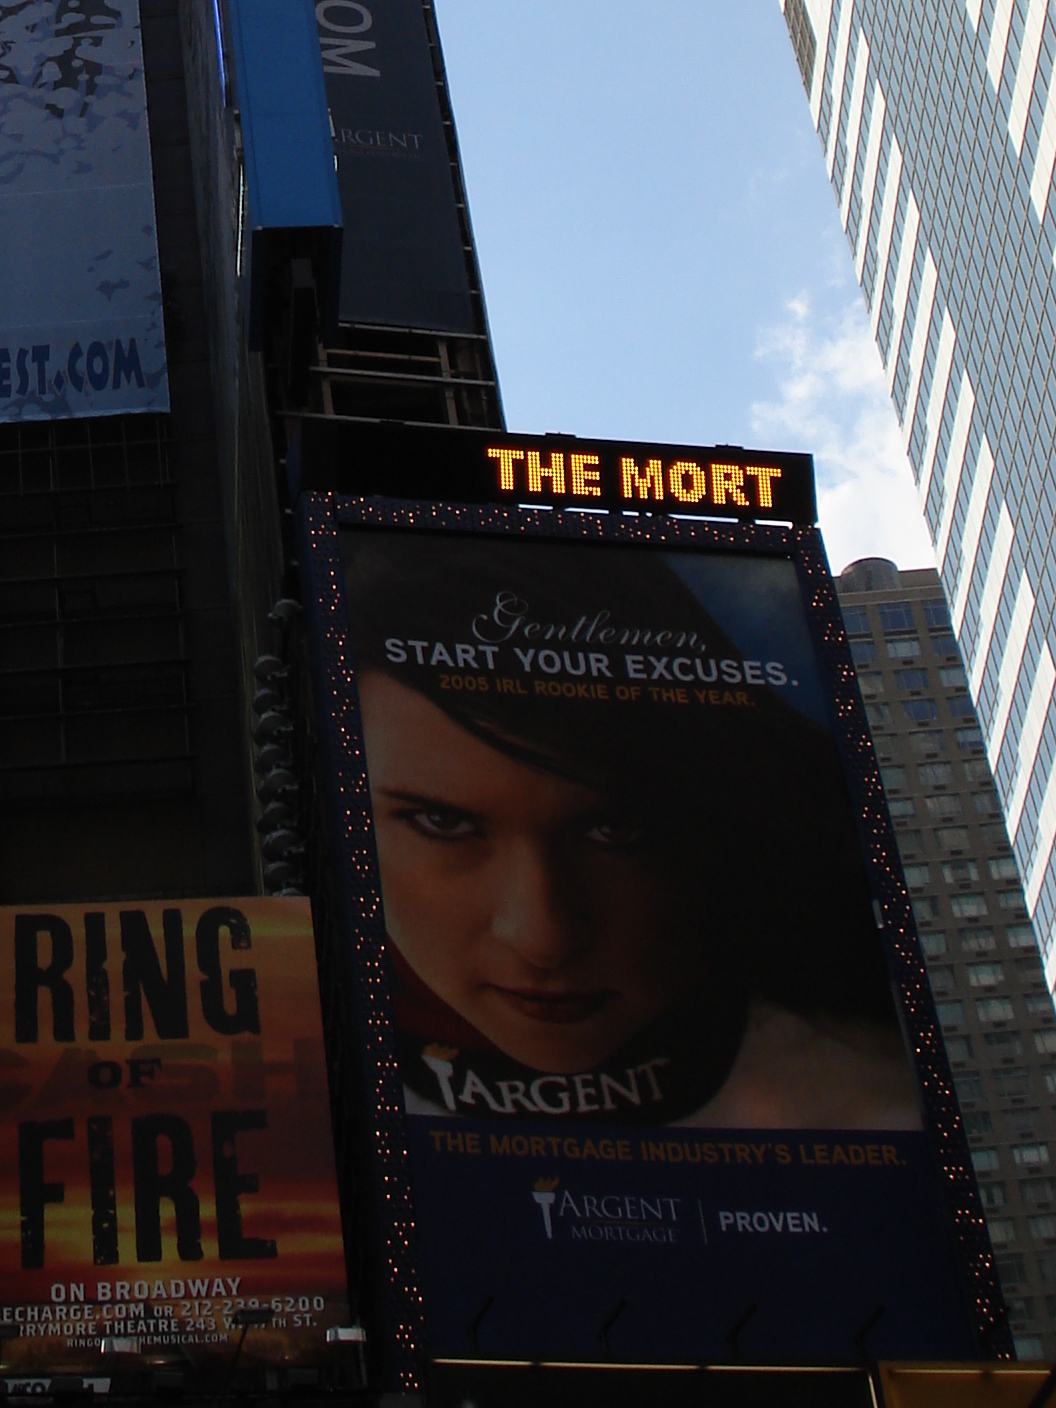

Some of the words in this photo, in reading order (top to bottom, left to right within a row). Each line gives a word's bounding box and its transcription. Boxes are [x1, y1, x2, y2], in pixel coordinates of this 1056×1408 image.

[335, 128, 424, 150] RGENT
[487, 447, 603, 497] THE
[621, 457, 784, 508] MORT
[471, 590, 709, 654] Gentlemen,
[384, 638, 500, 671] START
[514, 646, 614, 679] YOUR
[626, 654, 801, 688] EXCUSES.
[438, 674, 491, 694] 2005
[496, 677, 528, 696] IRL
[535, 679, 610, 702] ROOKIE
[615, 685, 641, 702] OF
[648, 686, 690, 706] THE
[693, 688, 758, 709] YEAR.
[14, 906, 262, 1043] RING
[87, 1057, 162, 1090] OF
[458, 1055, 673, 1116] ARGENT
[428, 1130, 483, 1155] THE
[489, 1134, 634, 1162] MORTGAGE
[640, 1141, 793, 1166] INDUSTRY'S
[799, 1144, 907, 1167] LEADER.
[18, 1108, 278, 1270] FIRE
[558, 1189, 682, 1223] ARGENT
[570, 1224, 678, 1245] MORTGAGE
[718, 1209, 829, 1235] PROVEN.
[51, 1282, 86, 1304] ON
[97, 1277, 243, 1303] BROADWAY
[103, 1319, 180, 1335] THEATRE
[185, 1318, 217, 1332] 243
[293, 1313, 318, 1327] ST.
[153, 1305, 174, 1318] OR
